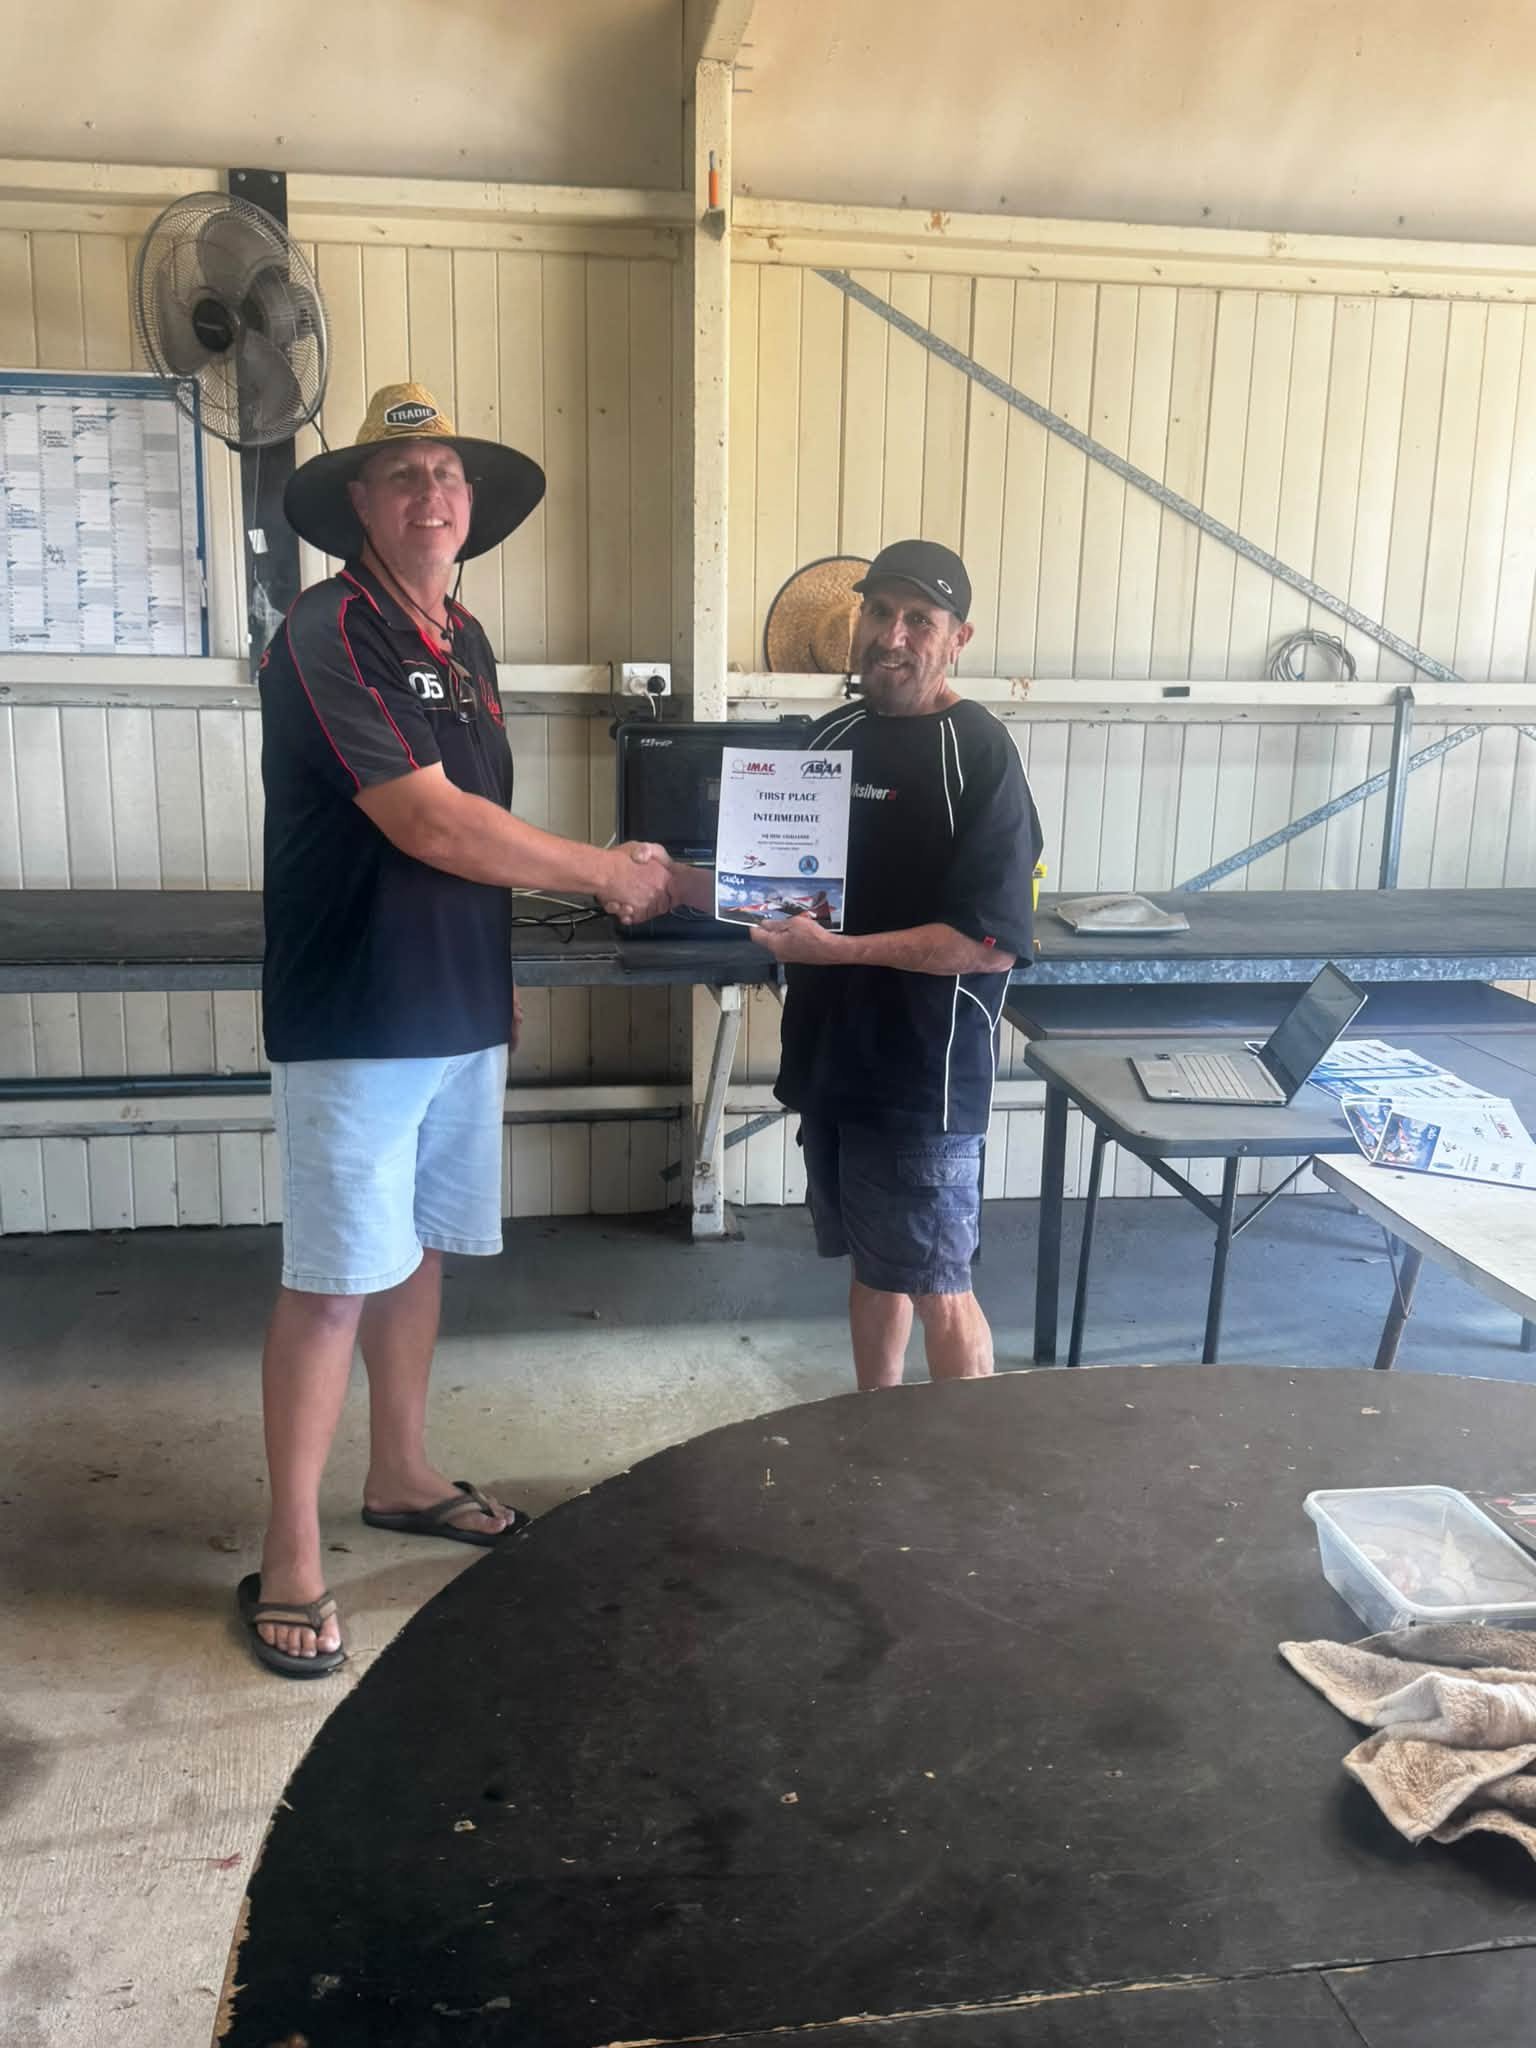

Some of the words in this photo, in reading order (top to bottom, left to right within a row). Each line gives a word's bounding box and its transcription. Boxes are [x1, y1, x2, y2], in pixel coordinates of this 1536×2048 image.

[390, 408, 433, 421] TRADIE
[408, 671, 444, 699] 05
[747, 762, 776, 772] IMAC
[759, 791, 786, 801] FIRST
[788, 792, 817, 801] PLACE
[851, 783, 890, 801] iksilver
[753, 812, 821, 823] INTERMEDIATE
